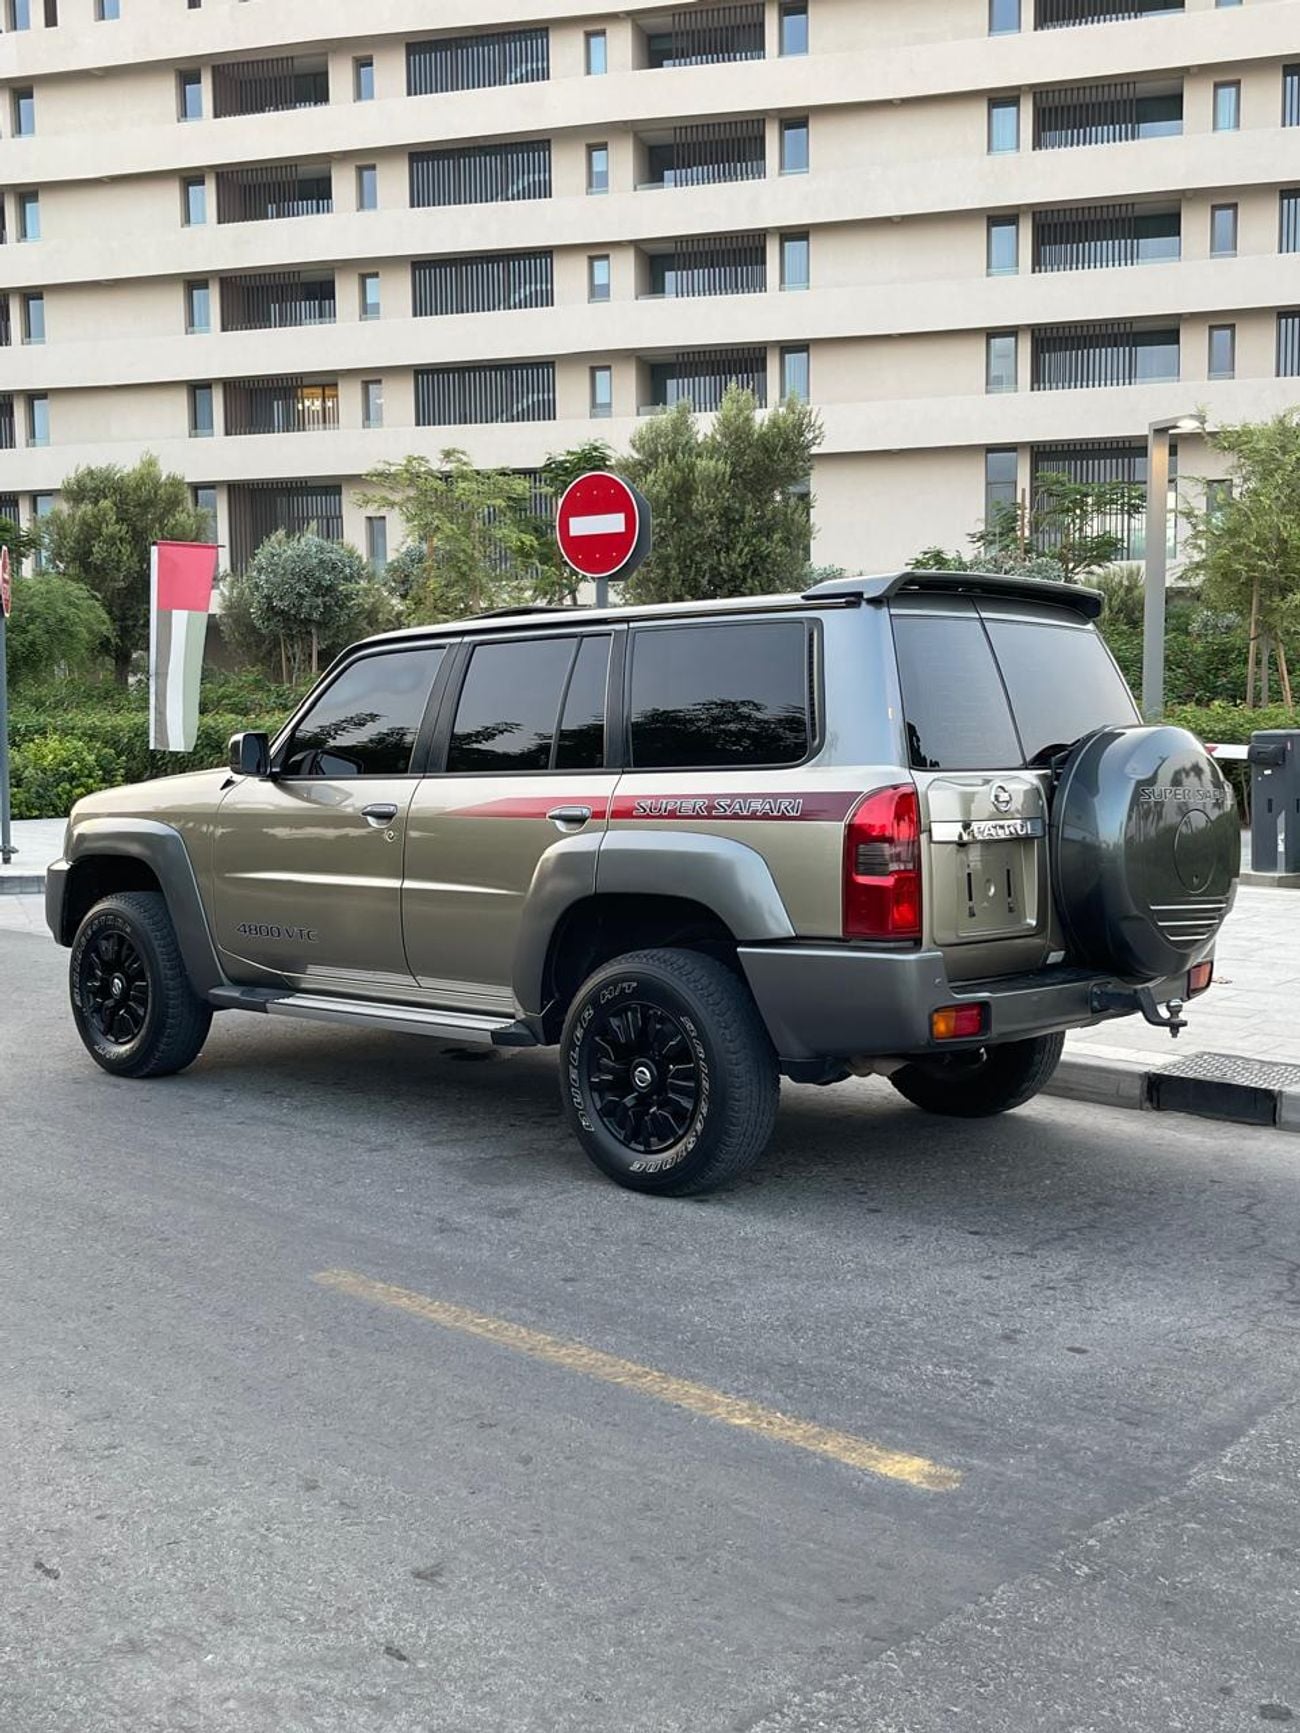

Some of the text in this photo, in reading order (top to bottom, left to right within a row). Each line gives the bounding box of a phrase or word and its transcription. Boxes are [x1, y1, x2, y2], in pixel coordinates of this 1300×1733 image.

[1140, 786, 1191, 802] SUPER
[633, 798, 803, 817] SUPER SAFARI
[236, 922, 319, 943] 4800 VTC
